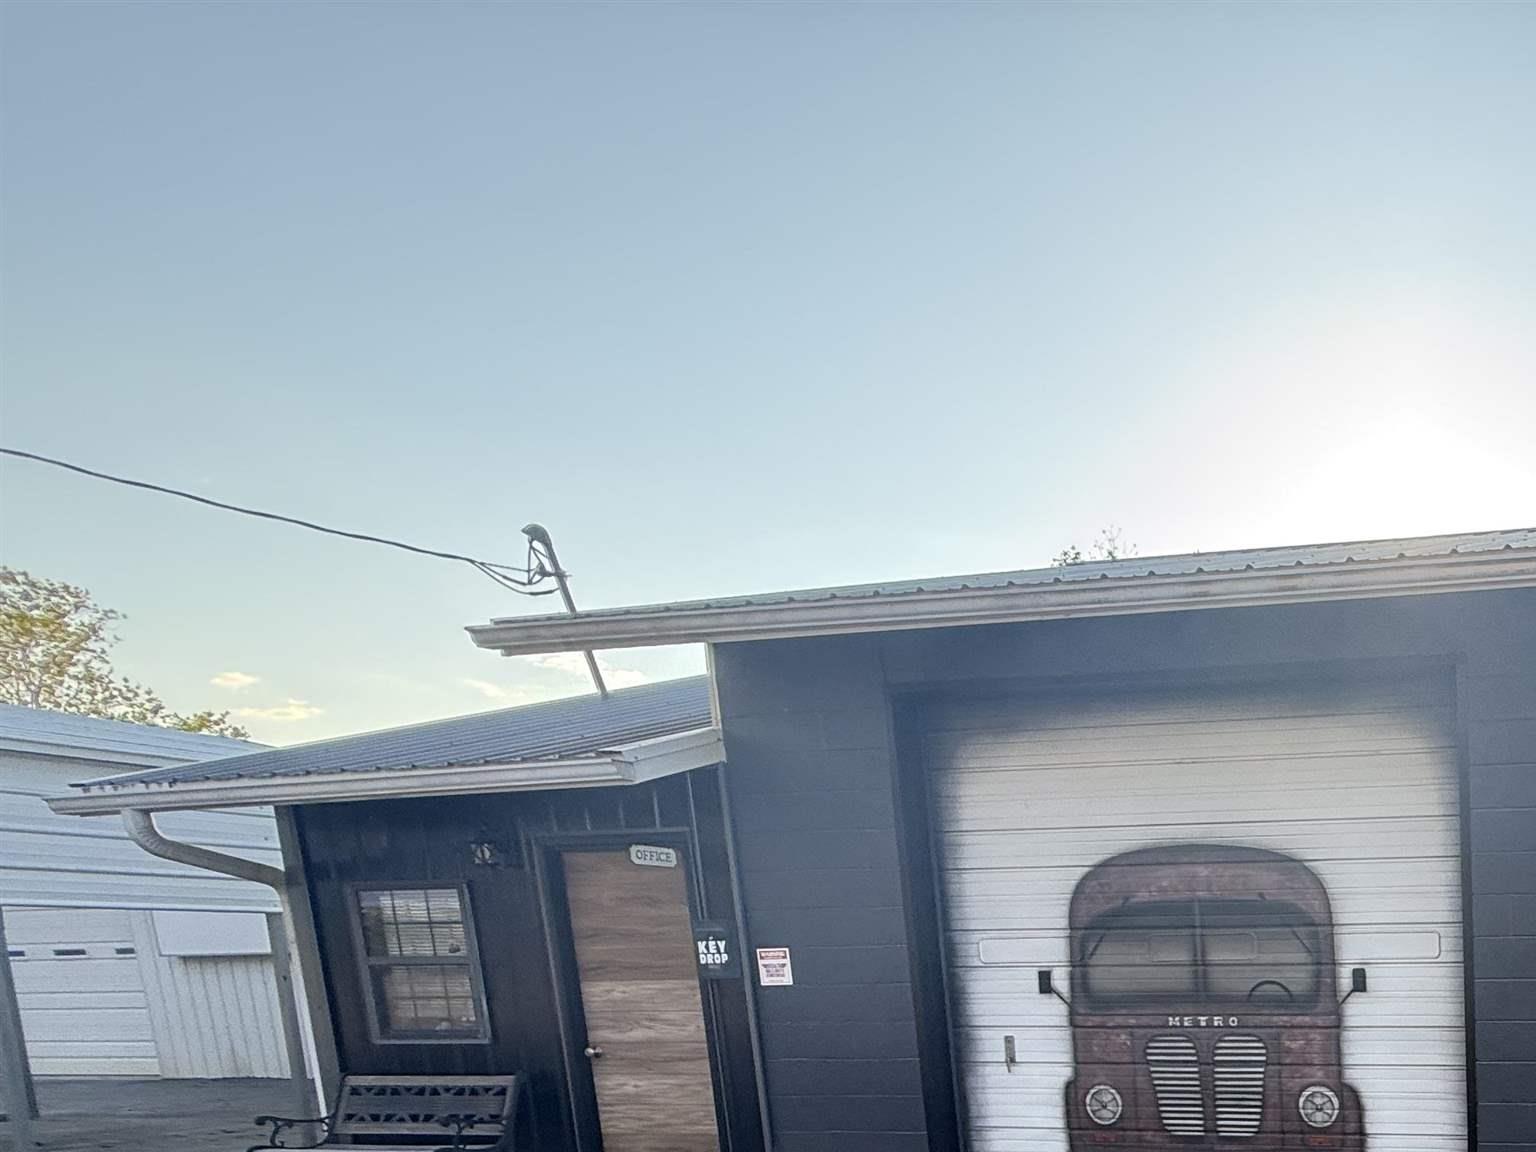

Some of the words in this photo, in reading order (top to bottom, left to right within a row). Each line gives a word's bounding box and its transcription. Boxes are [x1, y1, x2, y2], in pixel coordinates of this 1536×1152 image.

[636, 850, 673, 862] OFFICE
[697, 940, 726, 953] KEY
[699, 953, 728, 964] DROP
[1168, 1016, 1238, 1026] METRO
